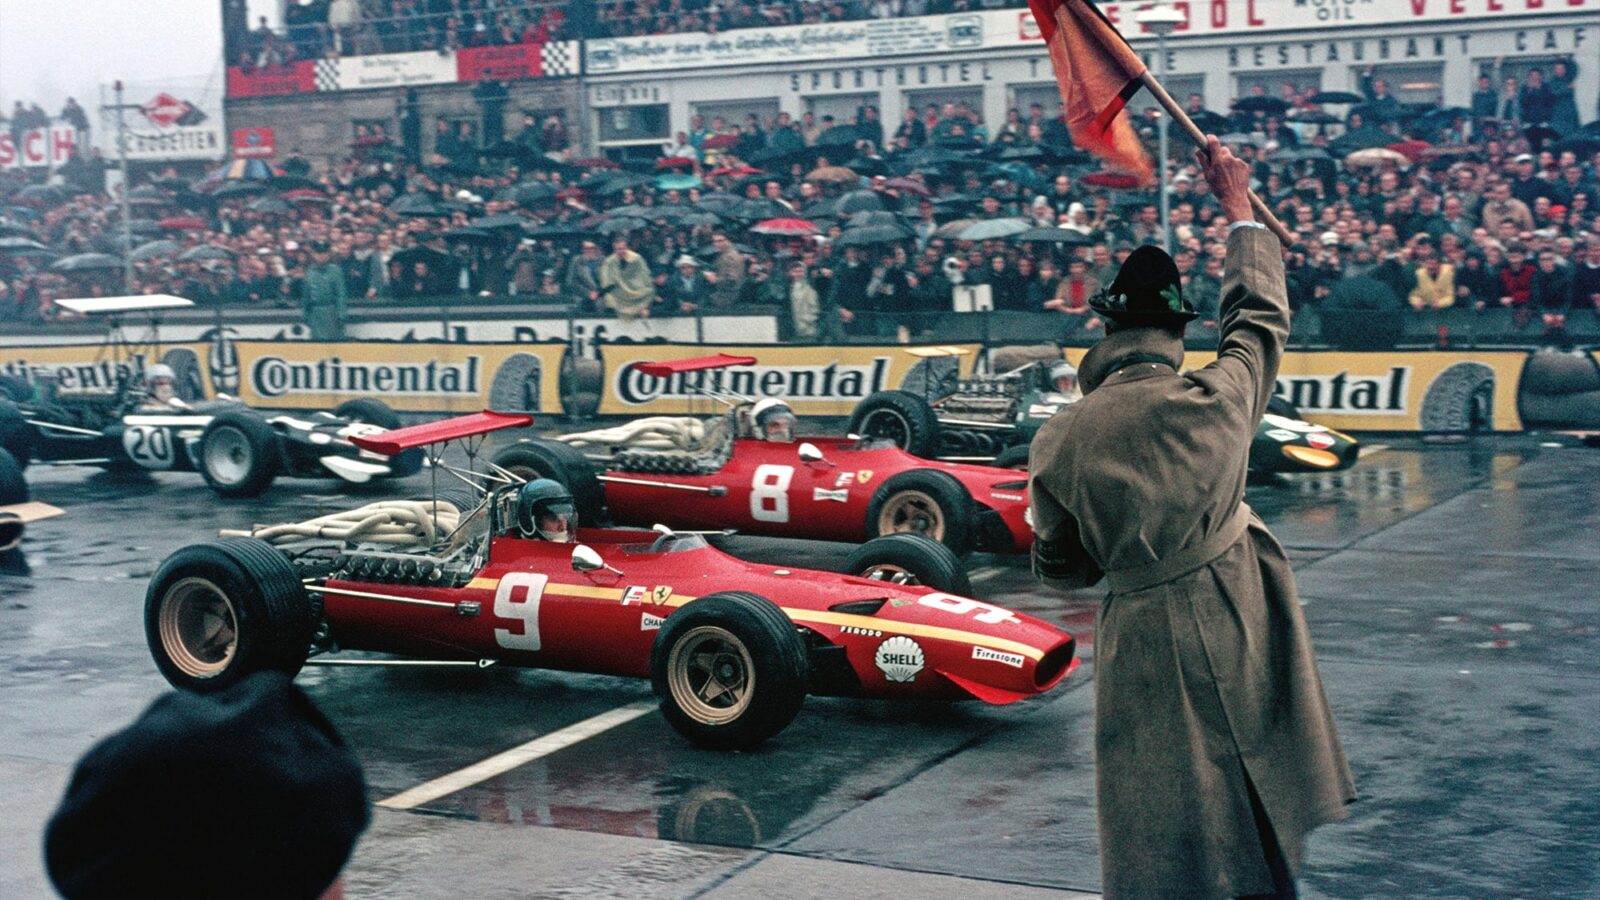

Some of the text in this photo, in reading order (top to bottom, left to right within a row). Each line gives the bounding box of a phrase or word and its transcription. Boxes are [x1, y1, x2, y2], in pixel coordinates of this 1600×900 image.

[1317, 7, 1354, 21] OIL
[1228, 34, 1471, 67] RESTAURANT
[253, 355, 479, 397] Continental
[131, 427, 169, 461] 20
[751, 464, 795, 523] 8
[493, 571, 549, 651] 9
[840, 625, 883, 638] FERODO
[882, 652, 919, 666] SHELL
[975, 648, 1023, 665] Firestone
